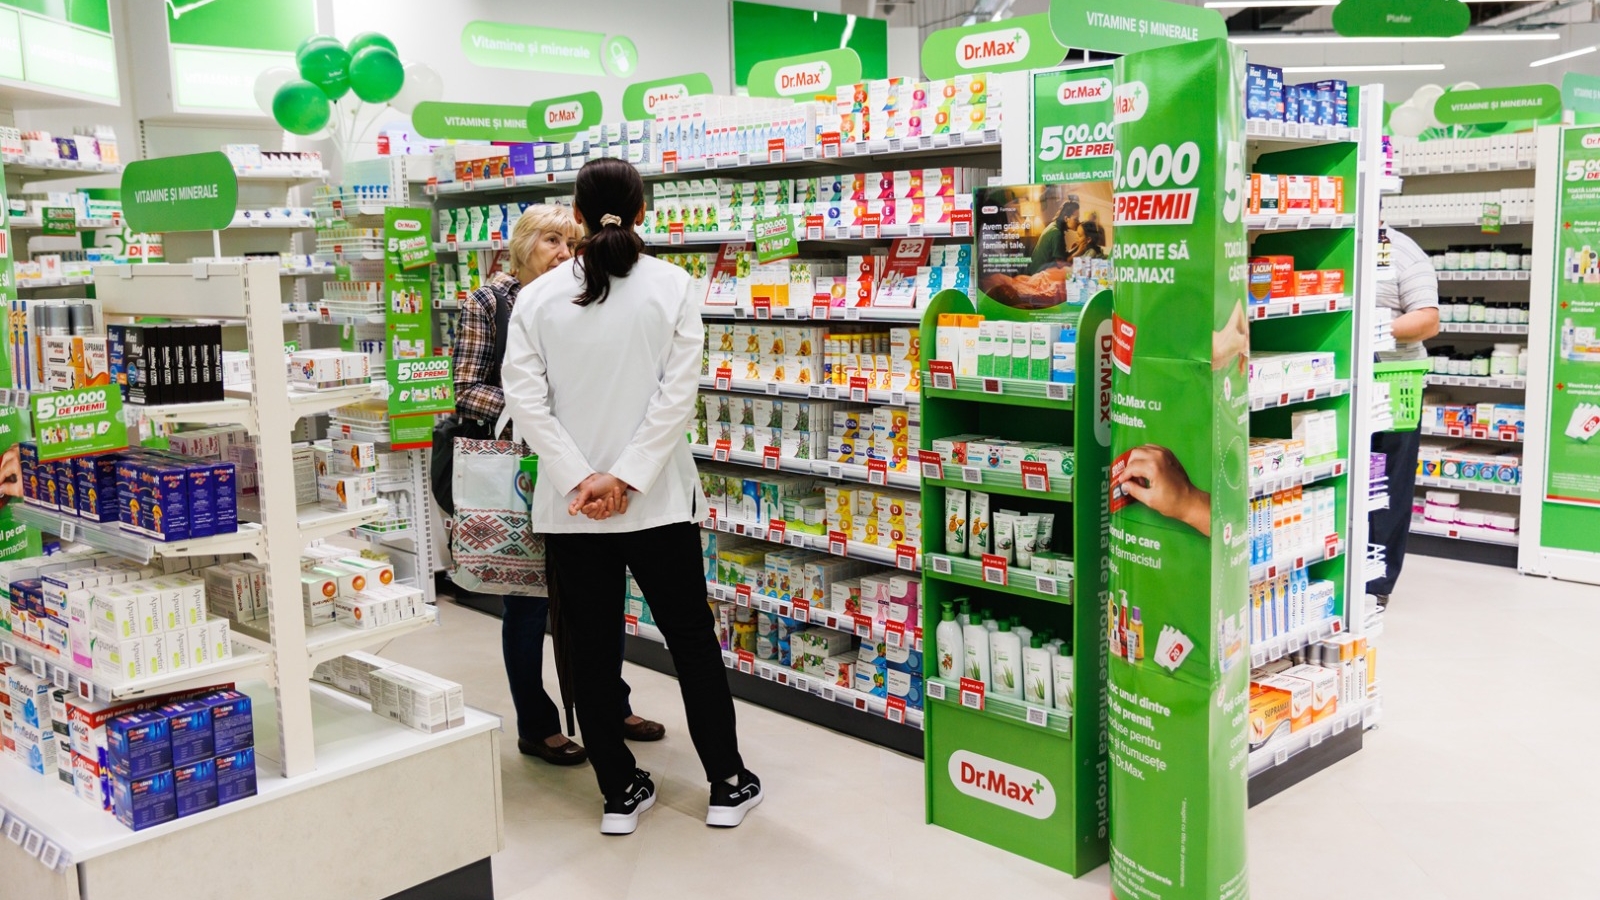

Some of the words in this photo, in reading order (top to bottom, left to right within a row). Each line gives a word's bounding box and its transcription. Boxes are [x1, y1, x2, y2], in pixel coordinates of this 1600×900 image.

[1086, 12, 1136, 32] VITAMINE
[1138, 20, 1148, 34] ȘI
[1150, 22, 1198, 41] MINERALE
[472, 34, 524, 53] Vitamine
[528, 42, 538, 59] și
[541, 44, 590, 58] minerale
[964, 40, 1015, 60] Dr.Max
[782, 72, 820, 88] Dr.Max
[1064, 86, 1101, 100] Dr.Max
[1451, 102, 1488, 112] VITAMINE
[1491, 101, 1499, 112] ȘI
[1501, 98, 1543, 108] MINERALE
[444, 116, 491, 128] VITAMINE
[493, 118, 502, 130] ȘI
[549, 110, 576, 123] Dr.Max
[1066, 146, 1082, 157] DE
[1041, 172, 1064, 181] TOATĂ
[1066, 171, 1091, 180] LUMEA
[135, 188, 169, 204] VITAMINE
[170, 187, 178, 205] ȘI
[179, 184, 218, 200] MINERALE
[1117, 193, 1191, 221] PREMII
[899, 243, 906, 253] 3
[914, 244, 921, 253] 2
[1124, 244, 1164, 260] POATE
[1168, 240, 1189, 260] SĂ
[1120, 267, 1174, 283] DR.MAX!
[397, 360, 449, 380] 500.000
[37, 390, 106, 419] 500.000
[58, 406, 70, 415] DE
[74, 402, 104, 413] PREMII
[1118, 395, 1145, 409] Dr.Max
[1148, 401, 1162, 410] cu
[1101, 466, 1110, 548] Familia
[0, 537, 28, 558] armacistul
[1126, 532, 1136, 544] pe
[1138, 537, 1160, 550] care
[1115, 544, 1161, 569] farmacistul
[1100, 557, 1108, 583] de
[1098, 588, 1108, 680] produse
[9, 677, 33, 697] Proflexon
[1119, 688, 1137, 704] unul
[1139, 697, 1171, 717] dintre
[1264, 702, 1289, 718] SUPRAMAX
[1099, 690, 1108, 755] marca
[1113, 701, 1121, 714] de
[1122, 708, 1154, 731] premii,
[14, 721, 38, 743] Proflexon
[1130, 730, 1161, 750] pentru
[1114, 737, 1120, 749] și
[1121, 740, 1167, 771] frumusețe
[1116, 755, 1145, 780] Dr.Max.
[961, 761, 1034, 806] Dr.Max
[1096, 761, 1108, 838] proprie
[1138, 864, 1172, 886] Voucherele
